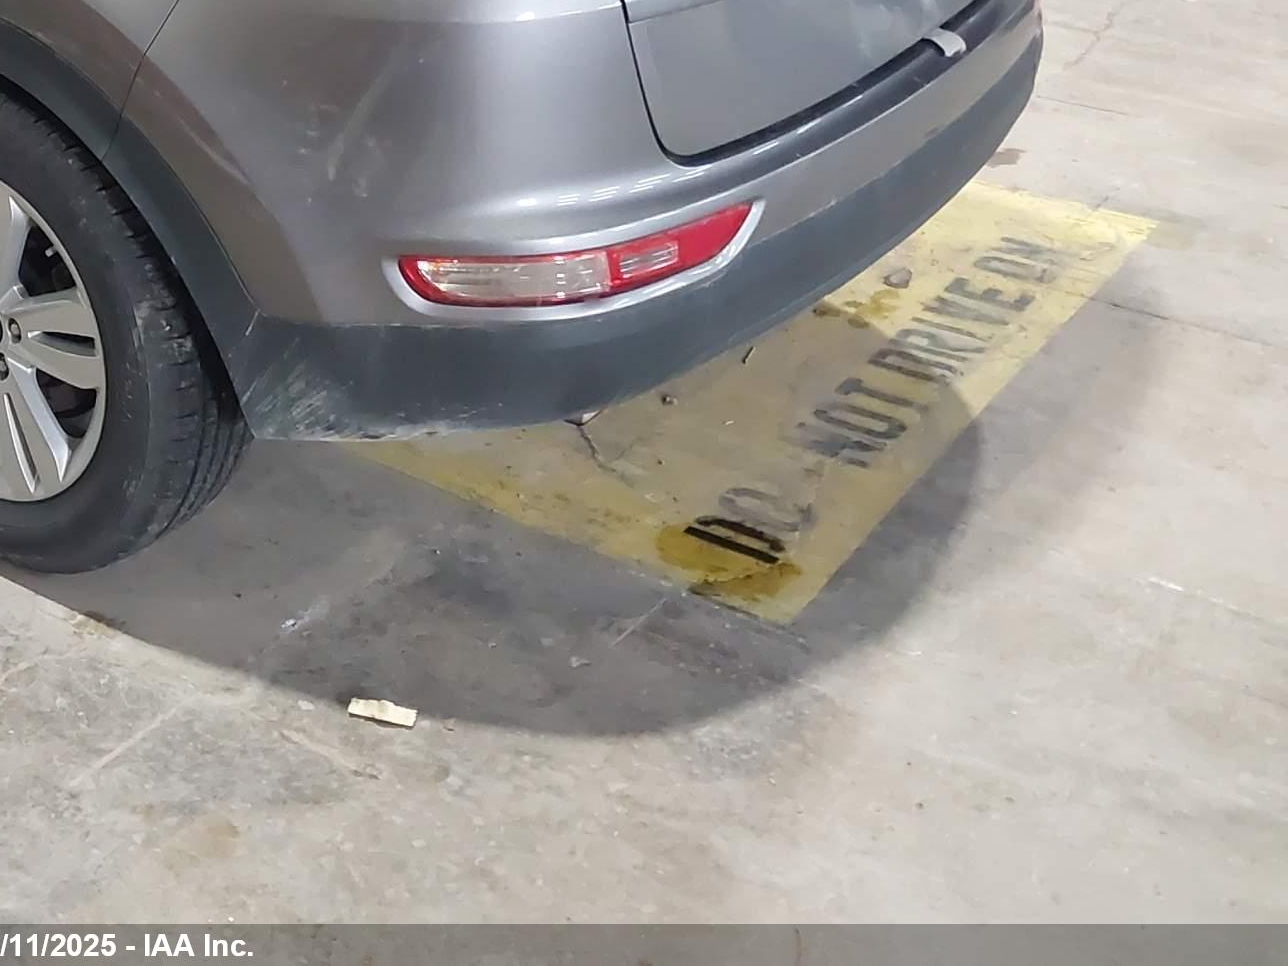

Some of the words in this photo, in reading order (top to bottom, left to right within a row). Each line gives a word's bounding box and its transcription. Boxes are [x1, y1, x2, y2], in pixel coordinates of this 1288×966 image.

[683, 487, 812, 564] DO
[797, 377, 929, 468] NOT
[867, 277, 1036, 383] DRIVE
